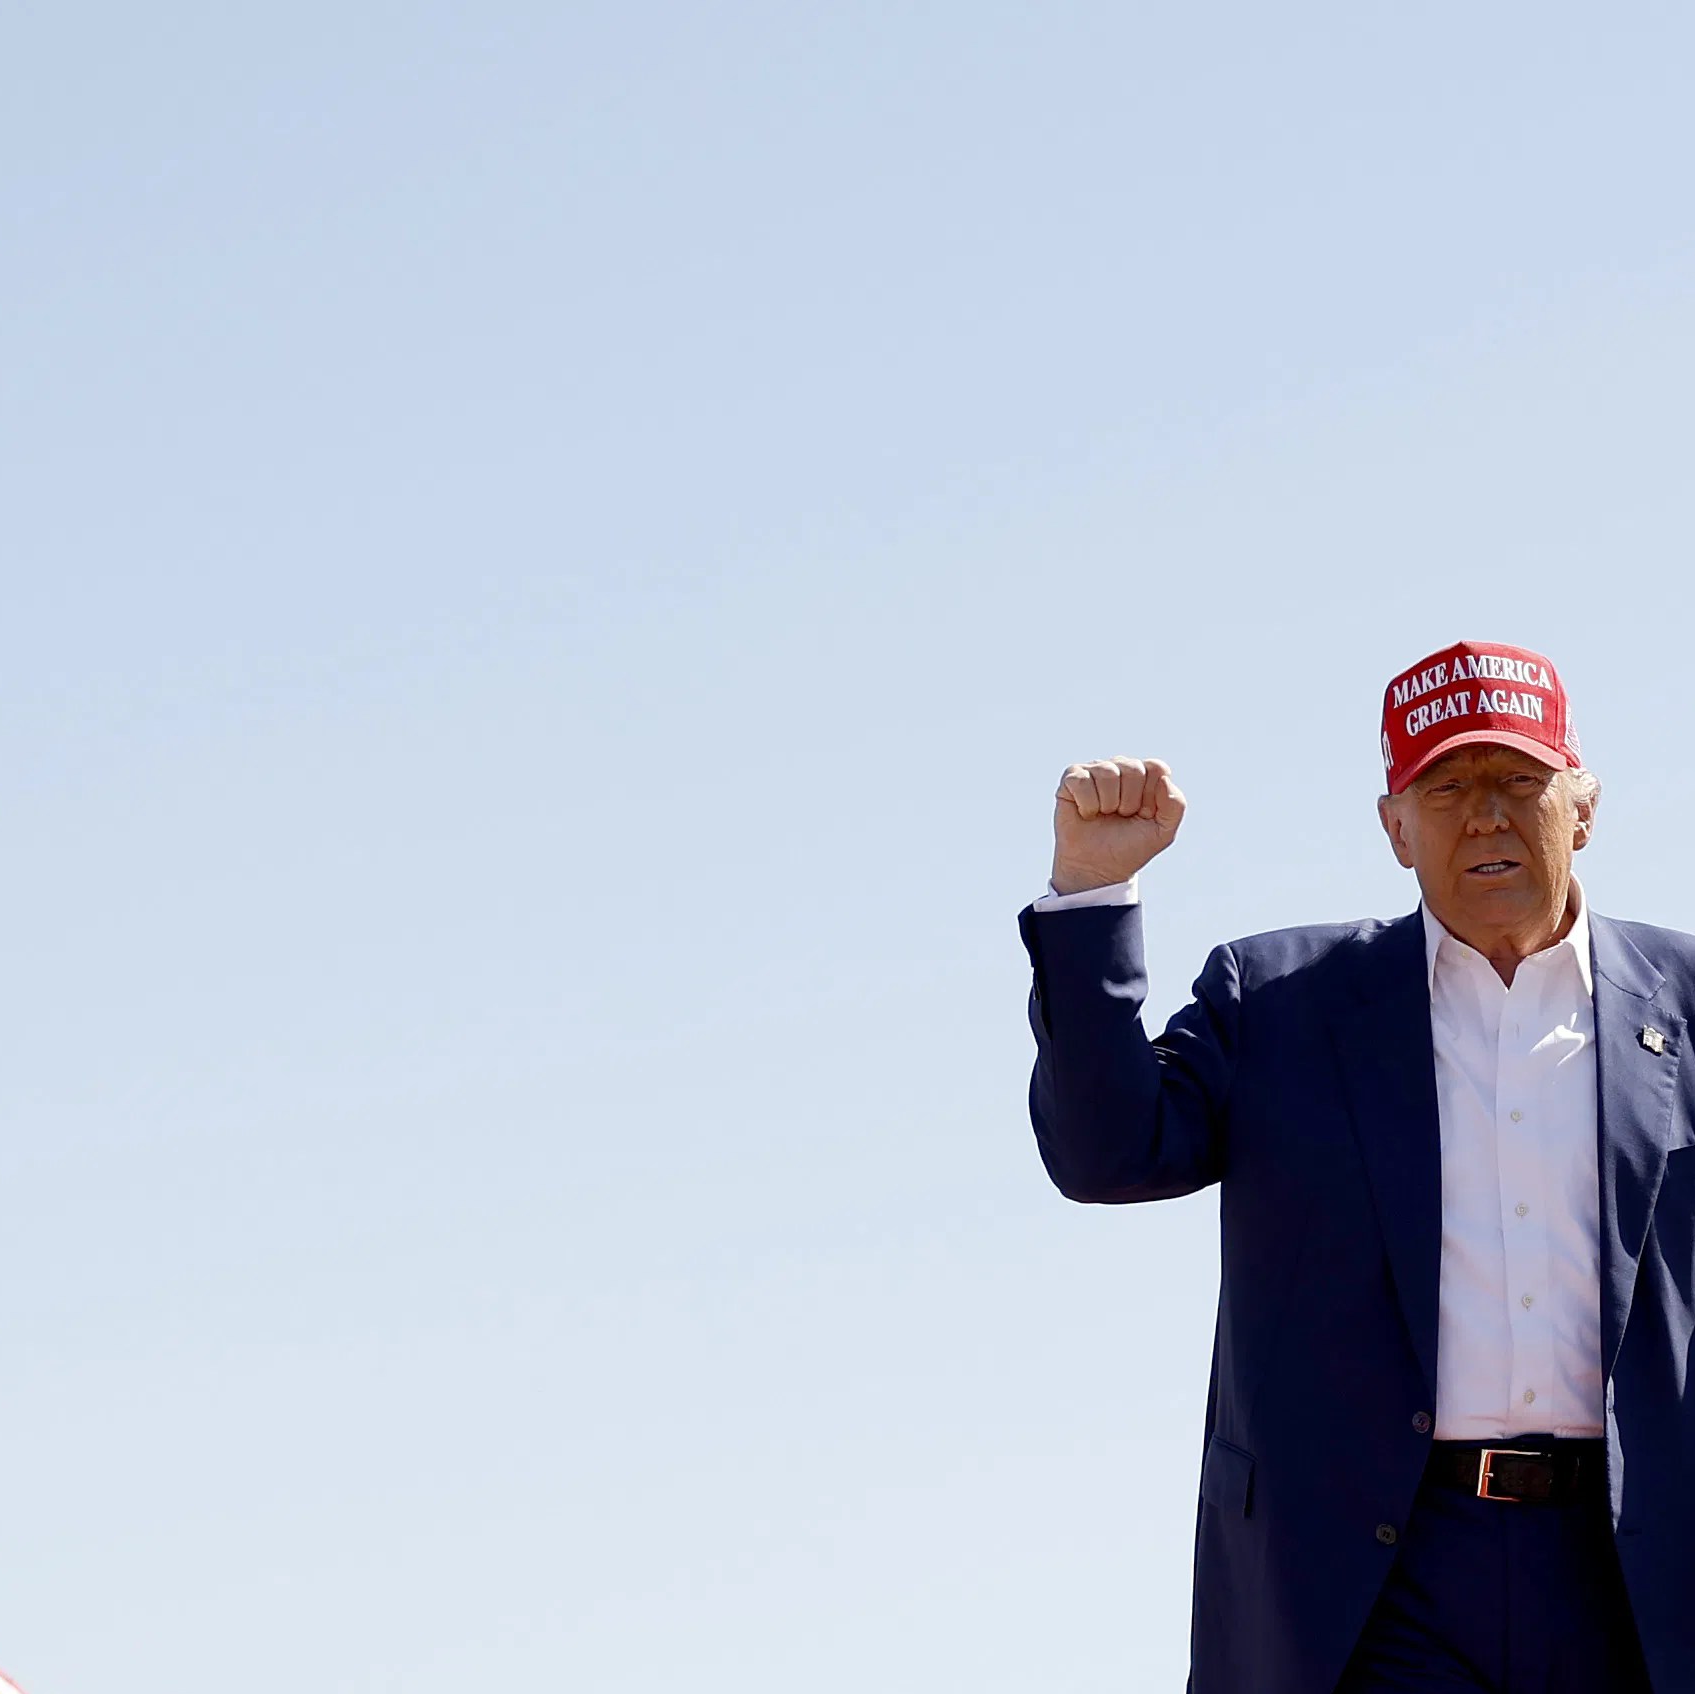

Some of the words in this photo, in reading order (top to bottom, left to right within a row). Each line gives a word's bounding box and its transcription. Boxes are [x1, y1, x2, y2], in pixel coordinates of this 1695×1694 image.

[1392, 662, 1449, 709] MAKE
[1451, 655, 1553, 691] AMERICA
[1405, 691, 1471, 737] GREAT
[1476, 689, 1544, 723] AGAIN
